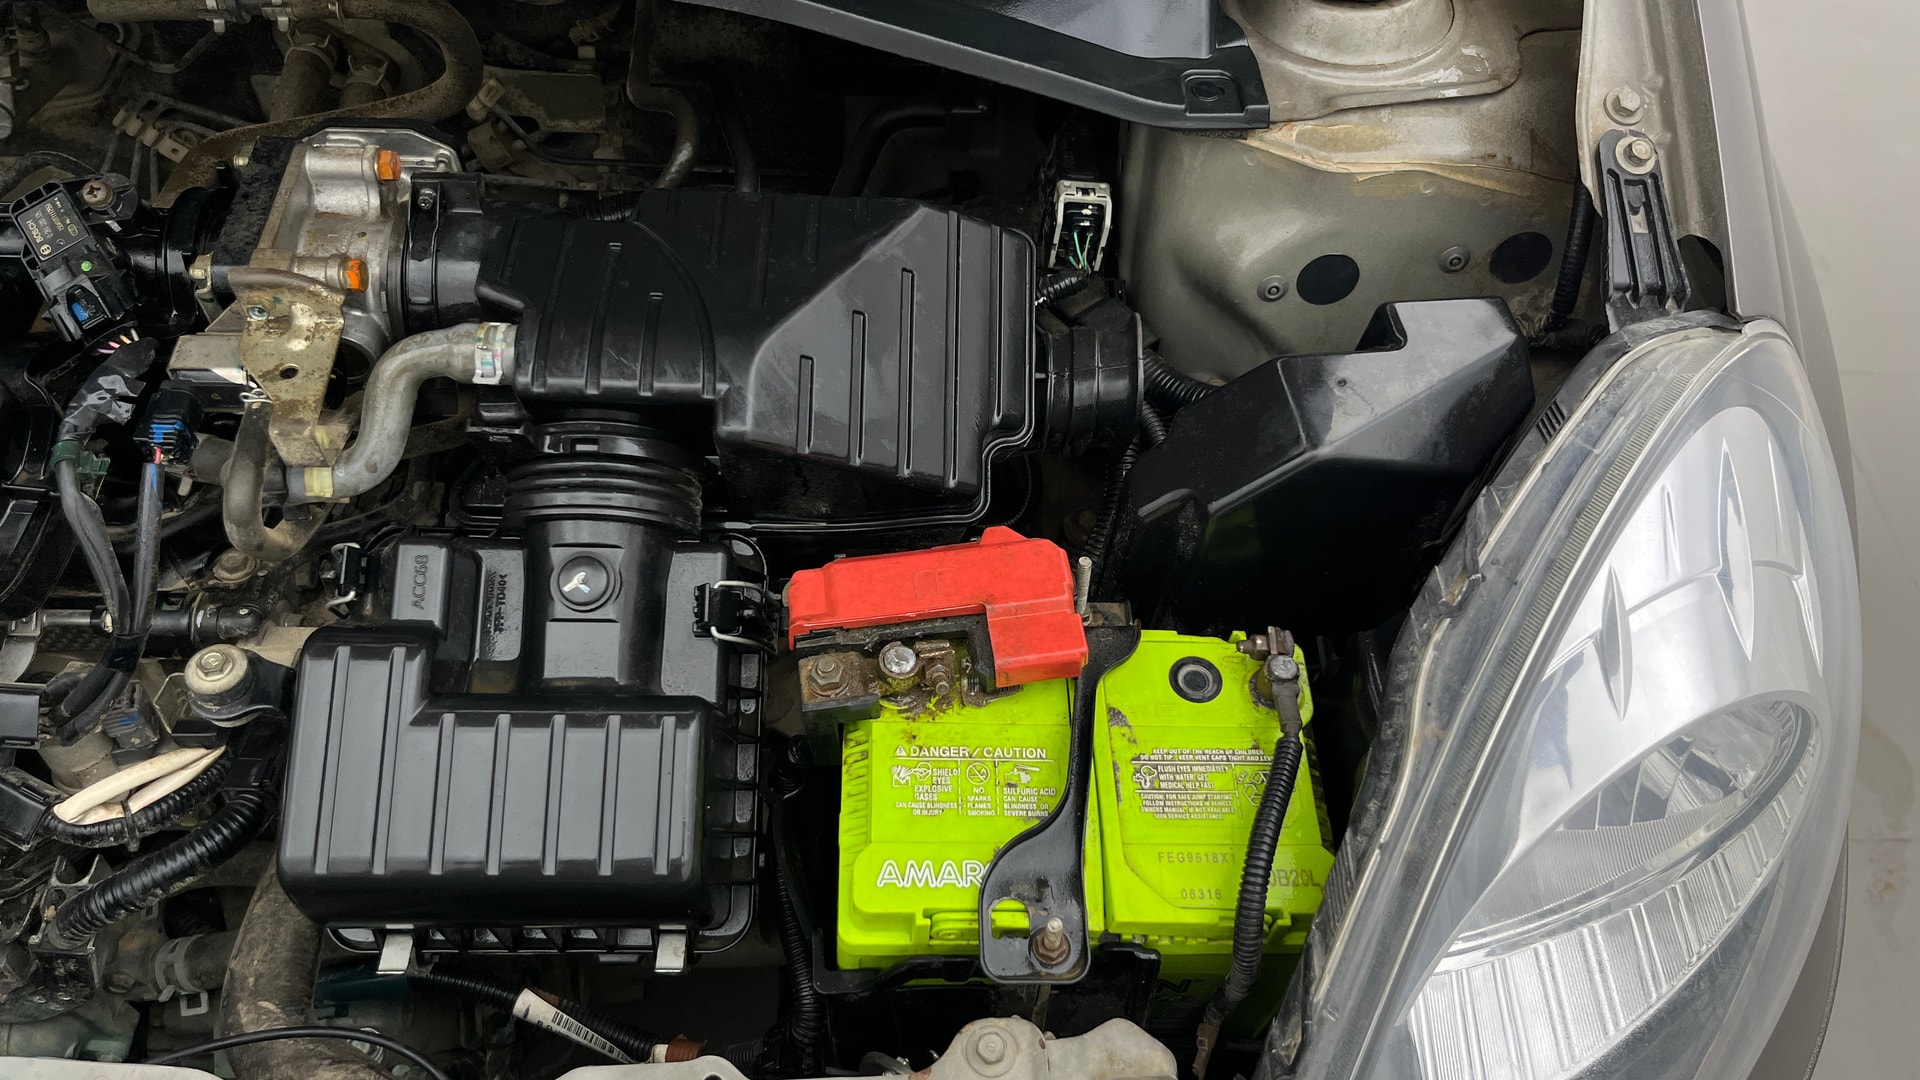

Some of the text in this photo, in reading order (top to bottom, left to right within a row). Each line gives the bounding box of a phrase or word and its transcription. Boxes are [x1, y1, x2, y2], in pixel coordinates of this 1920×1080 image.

[26, 219, 44, 243] BOSCH
[411, 554, 429, 610] ACC68
[910, 746, 970, 758] DANGER
[983, 747, 1046, 759] CAUTION
[933, 768, 958, 776] SHIELD
[1158, 765, 1228, 773] FLUSH EYES IMMEDIATELY
[933, 776, 951, 785] EYES
[1159, 773, 1174, 781] WITH
[1197, 773, 1207, 781] GET
[915, 784, 953, 793] EXPLOSIVE
[1160, 781, 1184, 789] MEDICAL
[1185, 781, 1200, 789] HELP
[1003, 787, 1056, 796] SULFURIC ACID
[1018, 795, 1038, 803] CAUSE
[927, 801, 957, 809] BLINDNESS
[1003, 802, 1037, 810] BLINDNESS
[876, 859, 991, 889] AMAR
[1181, 887, 1222, 900] 06316
